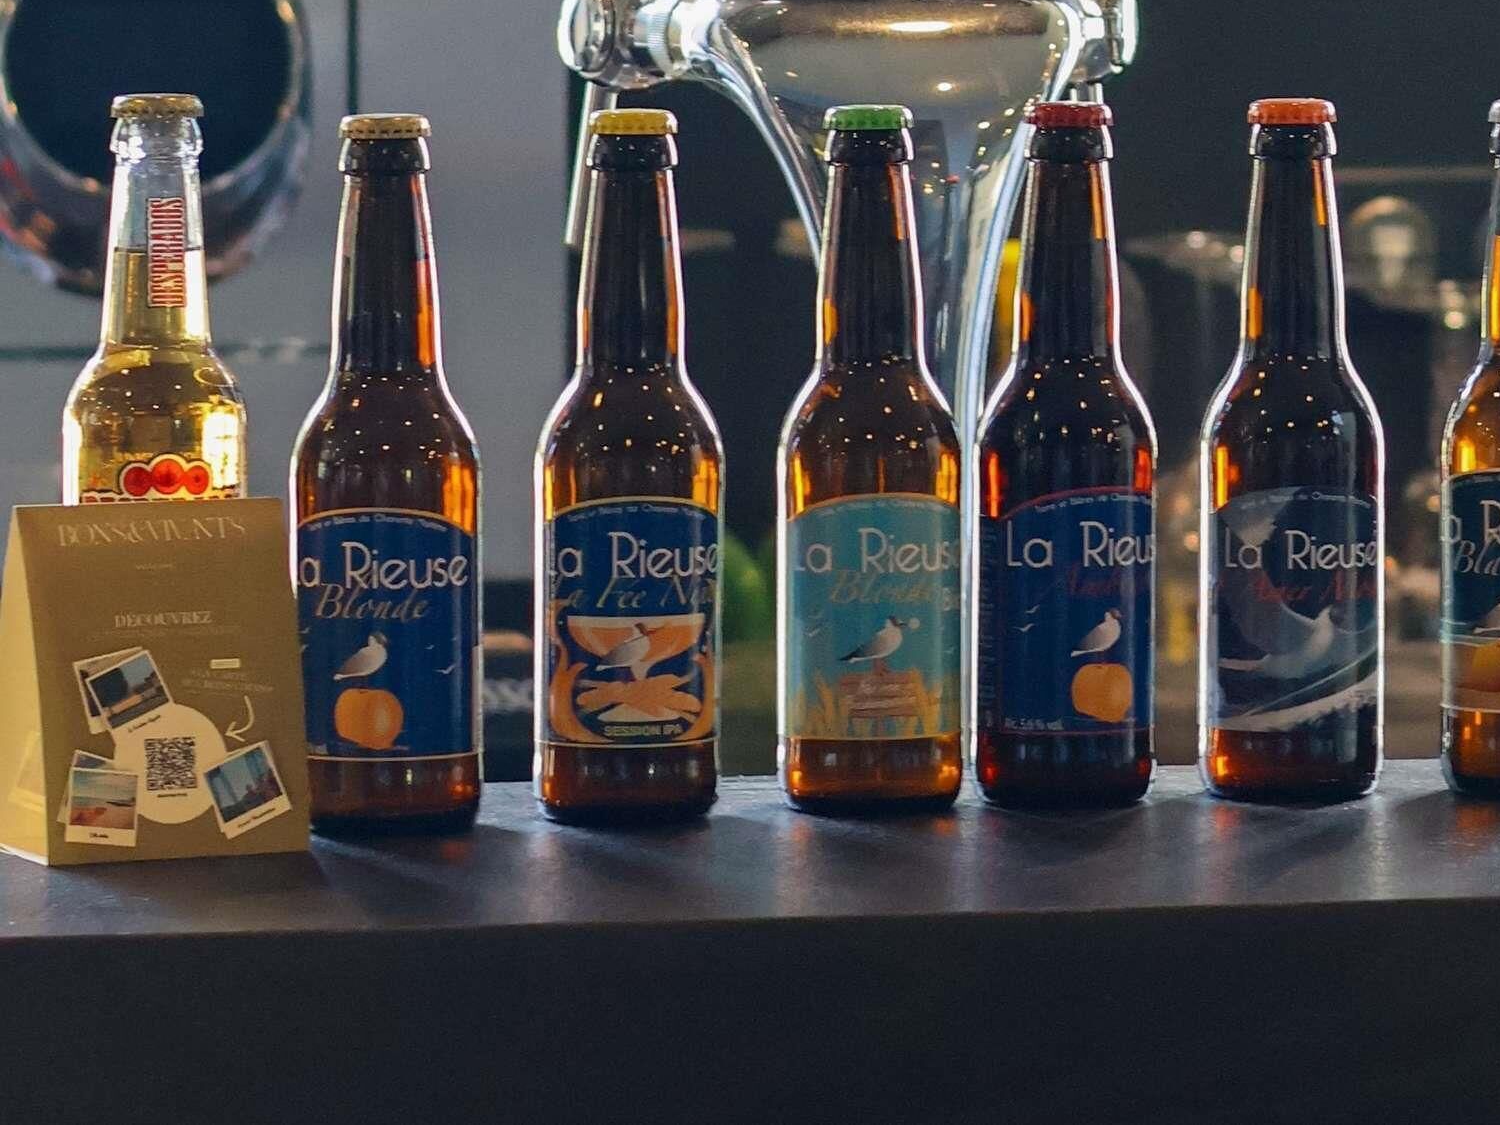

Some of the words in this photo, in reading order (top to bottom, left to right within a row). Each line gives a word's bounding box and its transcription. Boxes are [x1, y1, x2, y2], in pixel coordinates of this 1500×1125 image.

[148, 197, 187, 307] DESPERADOS
[341, 540, 469, 590] Rieuse
[606, 530, 720, 579] Rieuse
[858, 526, 959, 575] Rieus
[1007, 519, 1054, 569] La
[1224, 526, 1263, 570] La
[1284, 529, 1378, 571] Rieuse
[314, 582, 429, 622] Blonde
